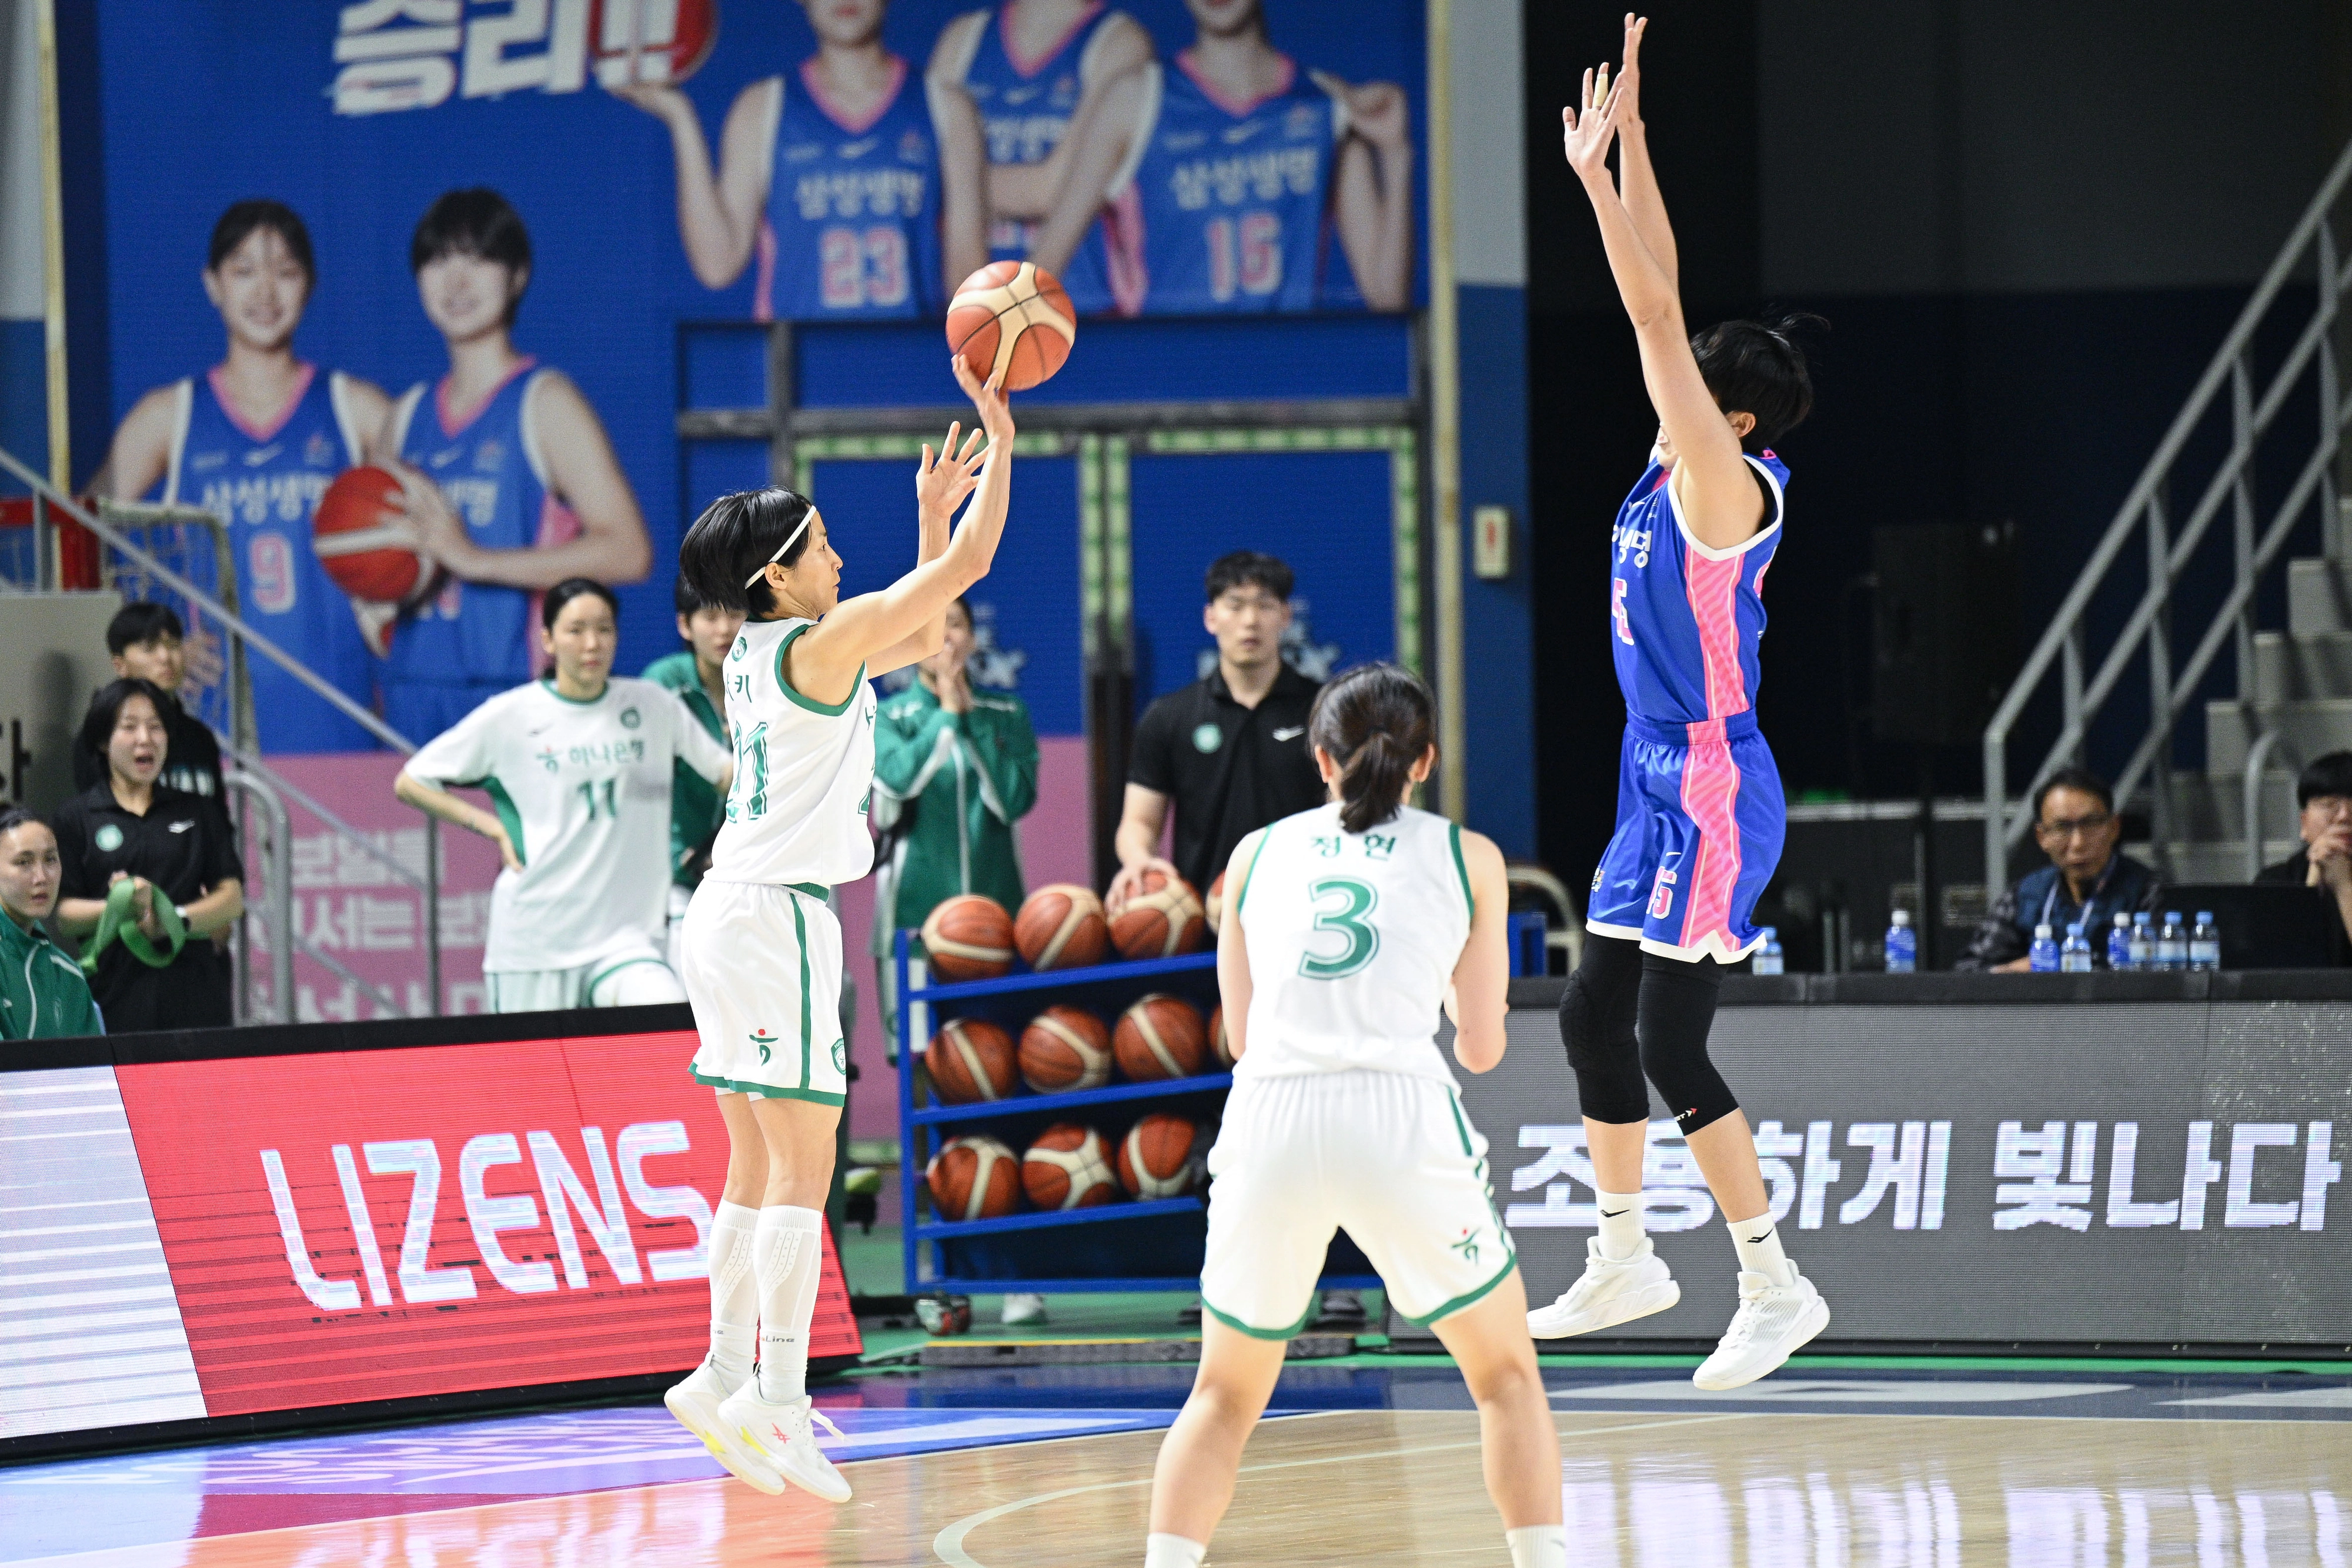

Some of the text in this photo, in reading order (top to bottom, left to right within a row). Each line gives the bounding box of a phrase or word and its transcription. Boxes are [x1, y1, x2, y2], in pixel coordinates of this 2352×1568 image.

[821, 227, 909, 308] 23
[249, 532, 295, 614] 9
[1298, 874, 1380, 981] 3
[260, 1120, 711, 1311] LIZENS
[1992, 1121, 2342, 1232] 빛나다
